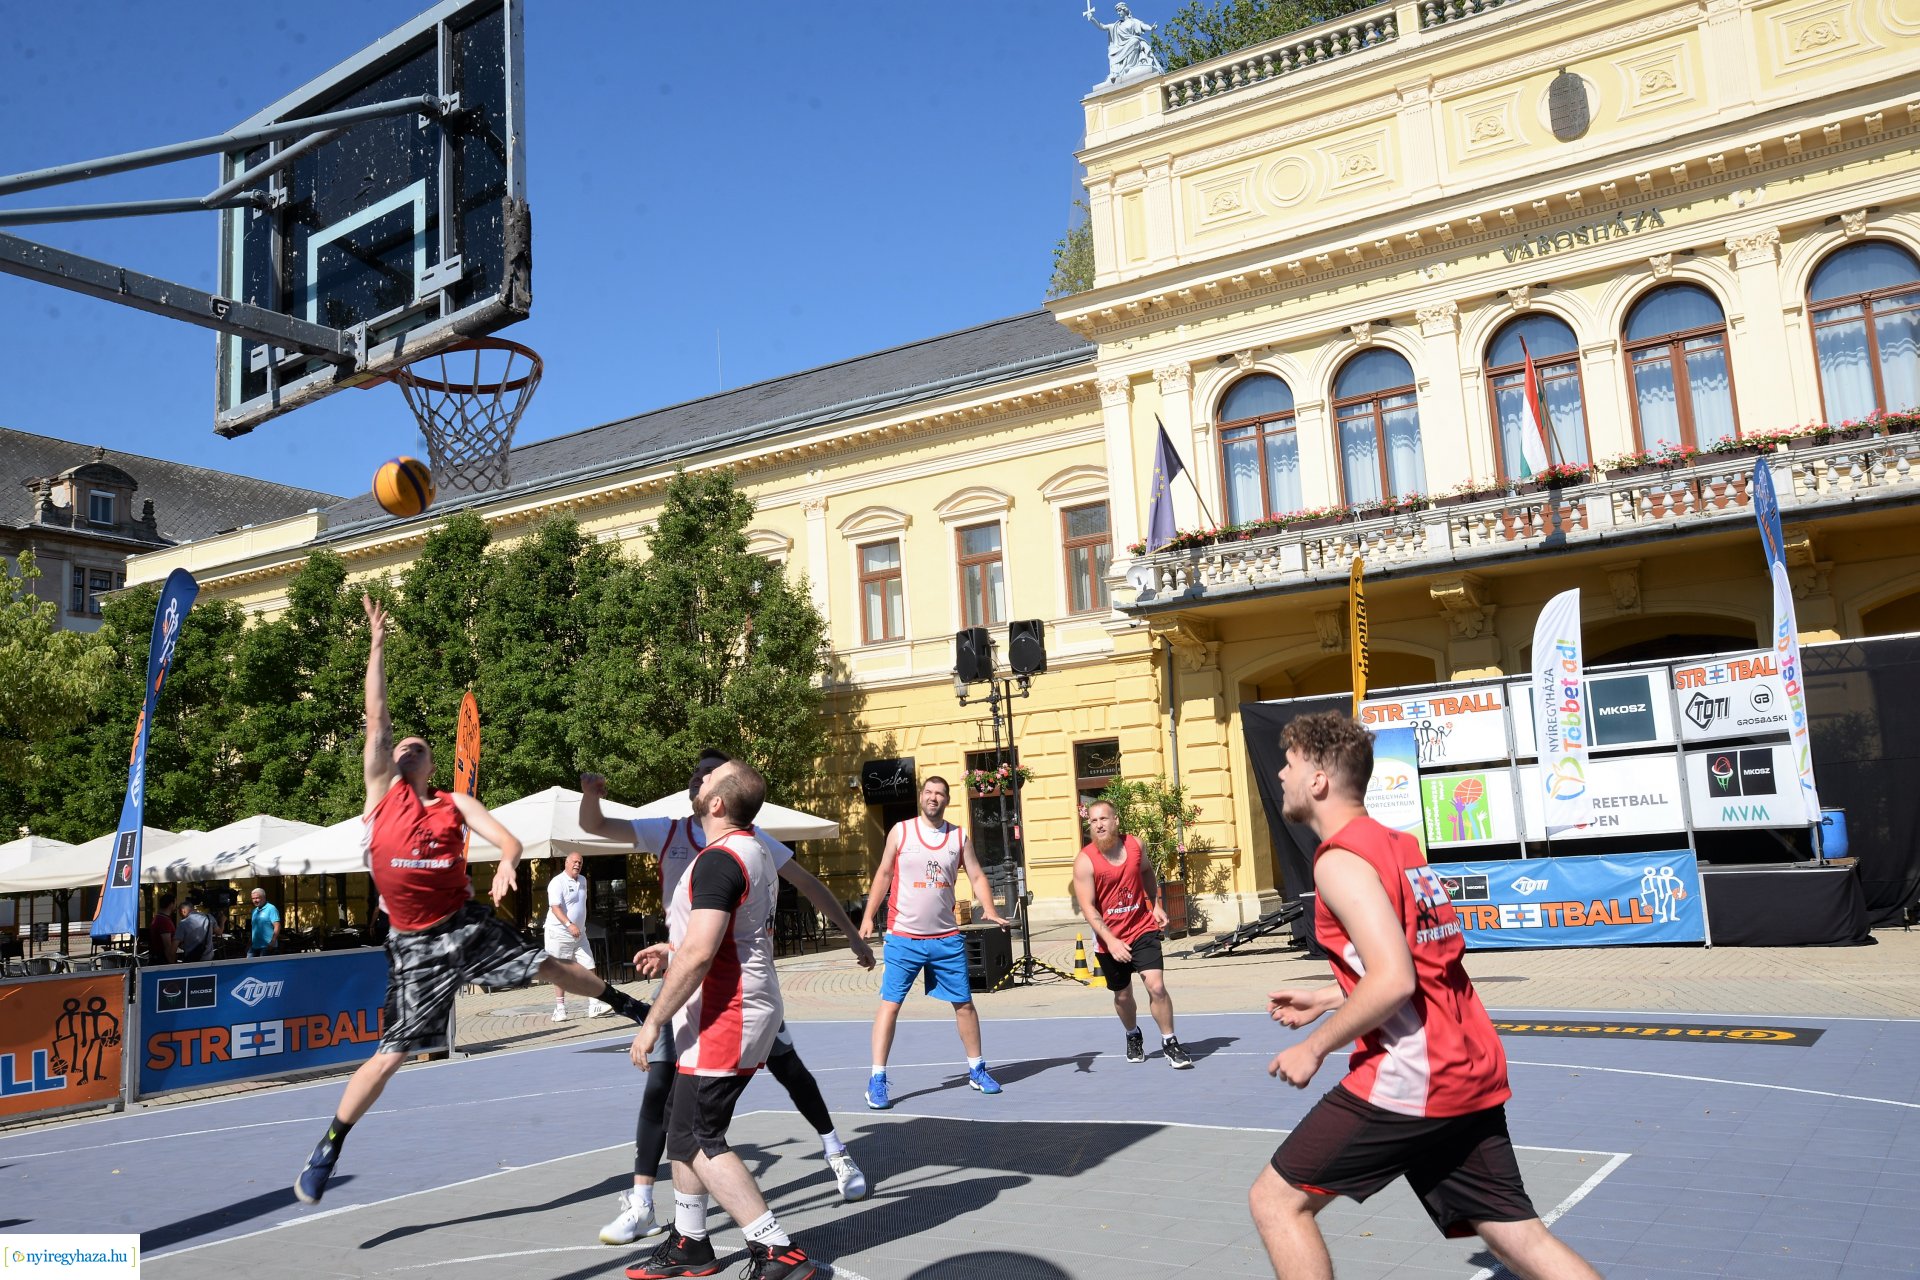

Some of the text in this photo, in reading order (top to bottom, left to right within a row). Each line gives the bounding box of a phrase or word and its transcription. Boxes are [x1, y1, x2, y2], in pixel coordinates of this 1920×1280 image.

[1500, 207, 1666, 264] VÁROSHÁZA
[1675, 656, 1779, 690] STREETBAL
[1361, 692, 1502, 725] STREETBALL
[1543, 667, 1560, 753] NYÍREGYHÁZA
[1555, 638, 1582, 752] Többet ad!
[1599, 703, 1648, 716] MKOSZ
[1743, 767, 1771, 776] MKOSZ
[1722, 804, 1770, 822] MVM
[1453, 898, 1653, 931] TREETBALL
[190, 987, 213, 995] MKOSZ
